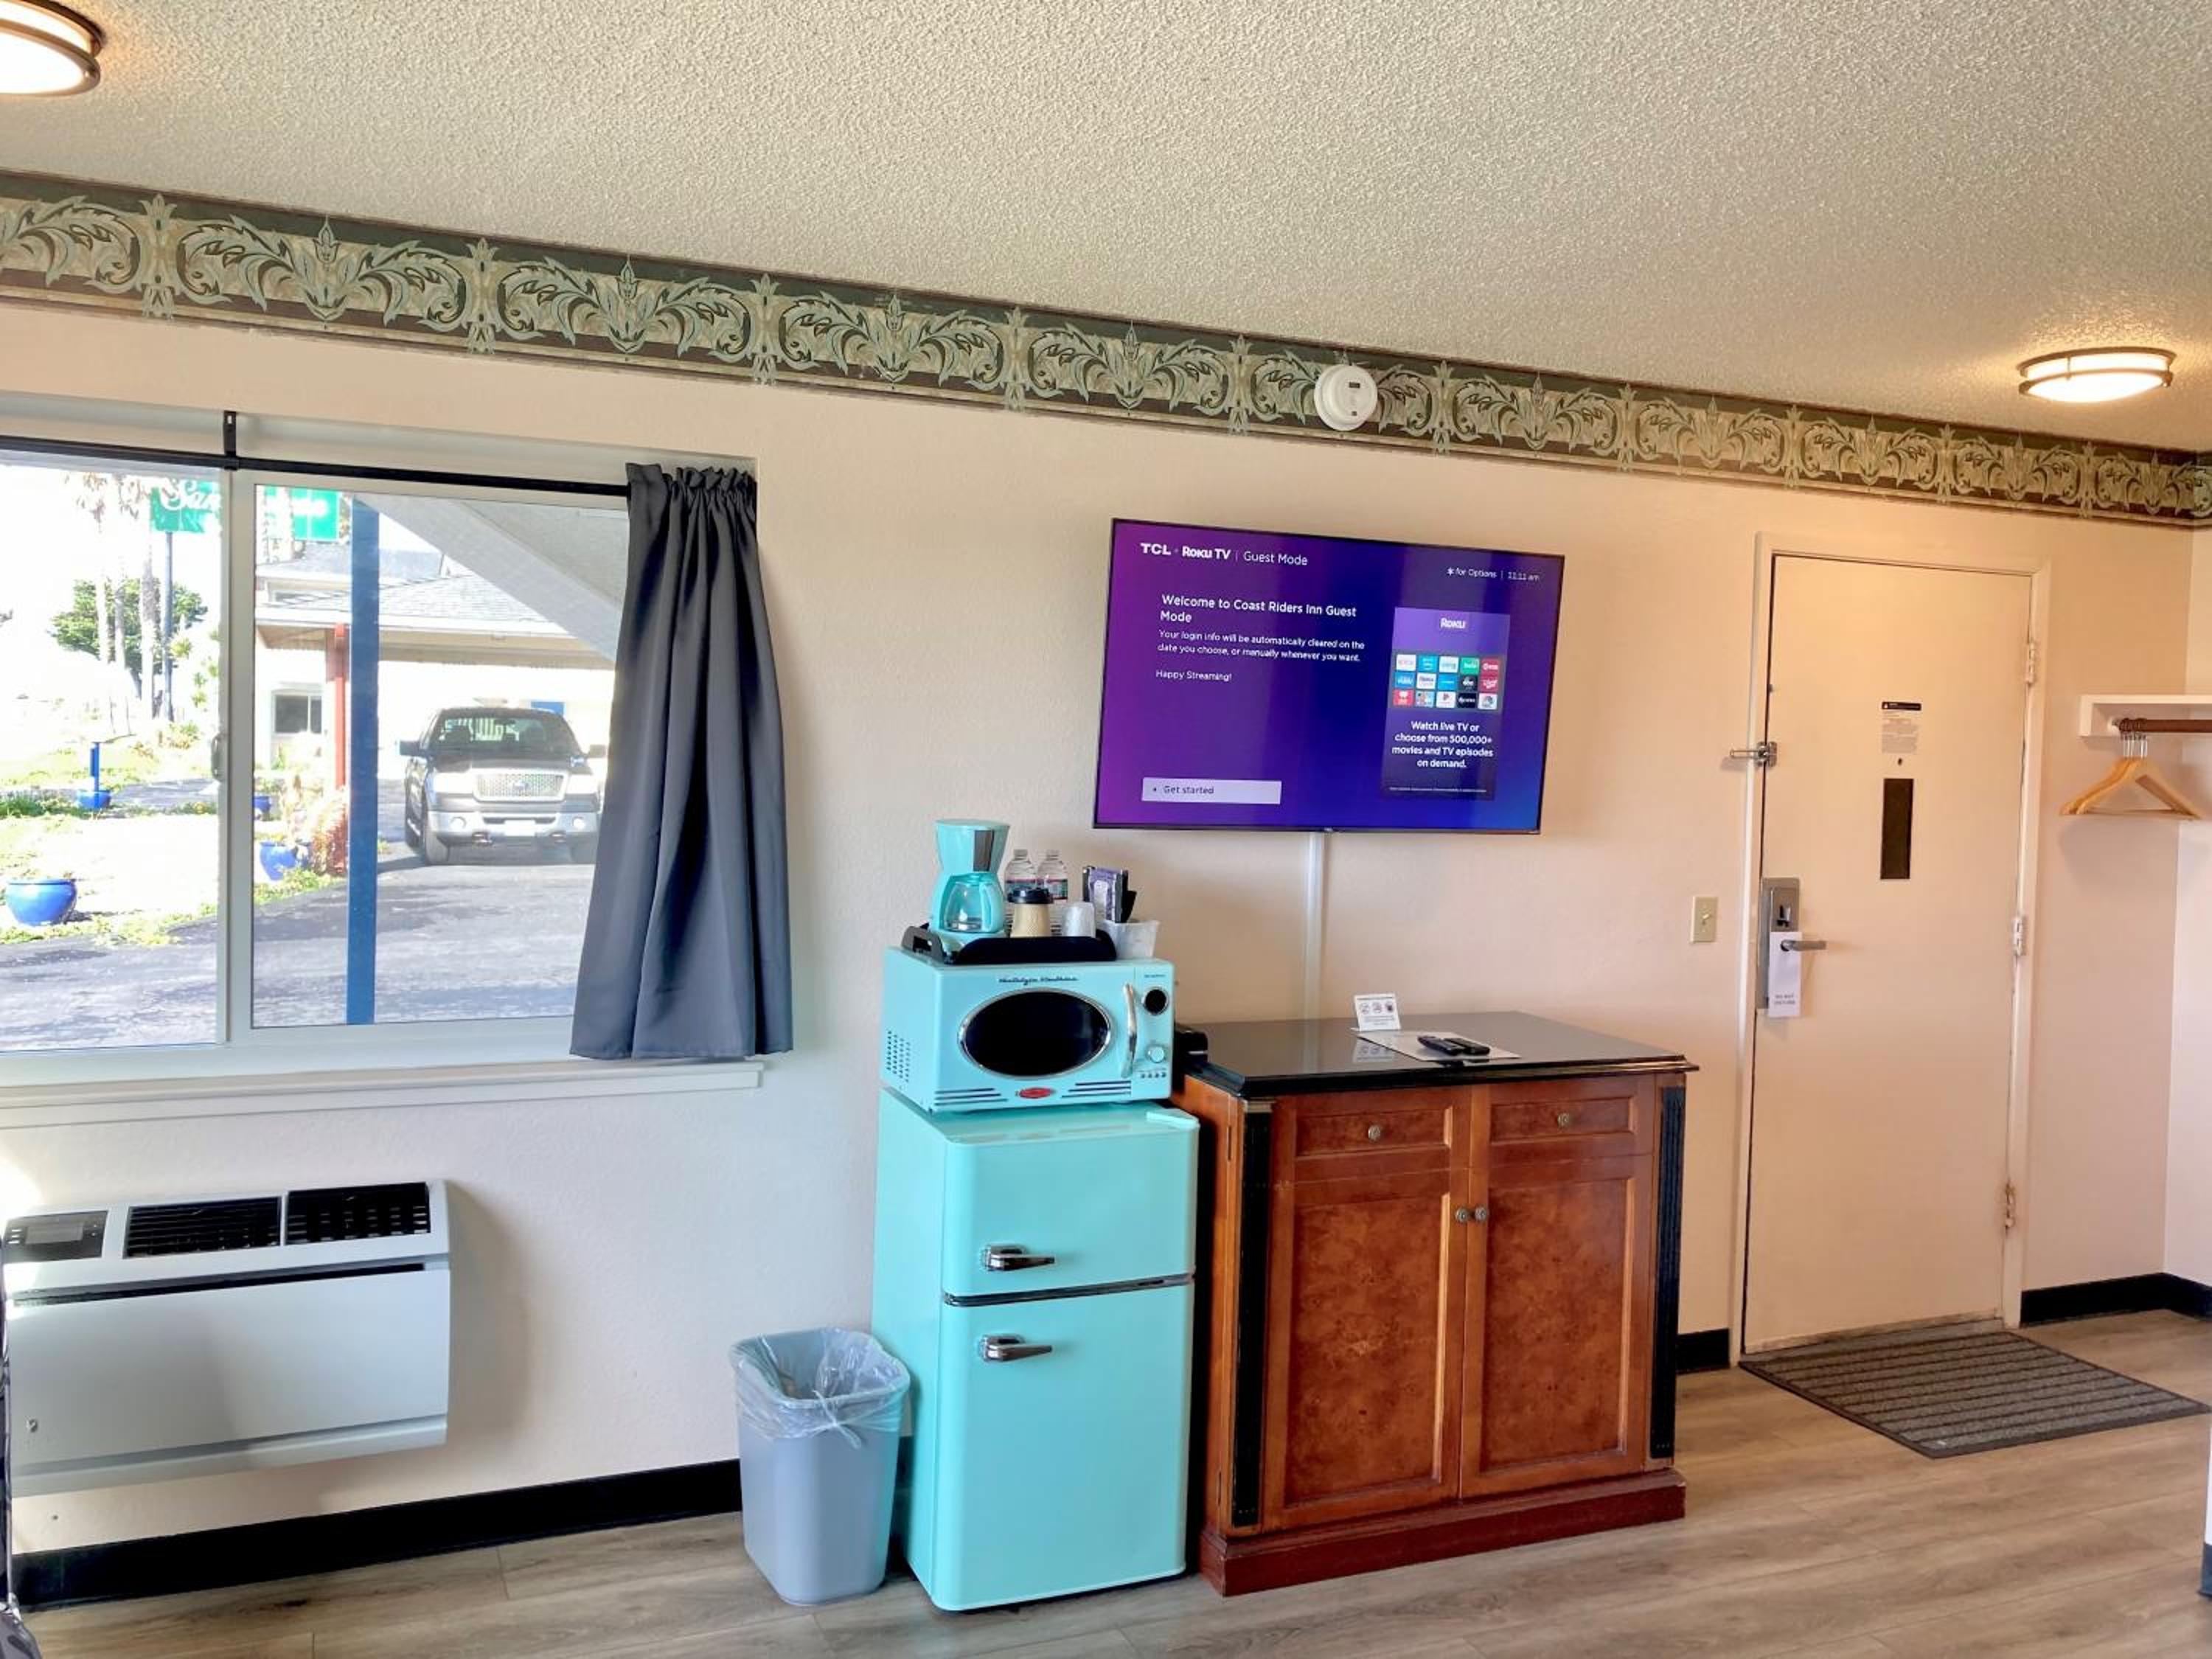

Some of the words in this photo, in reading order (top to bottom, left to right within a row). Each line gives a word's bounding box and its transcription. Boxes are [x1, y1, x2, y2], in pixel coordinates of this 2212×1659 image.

[1141, 543, 1171, 555] TCL
[1214, 548, 1231, 560] TV
[1244, 551, 1274, 563] Guest
[1278, 553, 1308, 566] Mode
[1455, 567, 1466, 575] for
[1468, 568, 1498, 579] Options
[1161, 594, 1215, 608] Welcome
[1218, 599, 1230, 609] to
[1234, 599, 1265, 611] Coast
[1268, 601, 1303, 614] Riders
[1306, 604, 1322, 614] Inn
[1326, 605, 1357, 617] Guest
[1160, 611, 1192, 622] Mode
[1159, 629, 1180, 639] Your
[1181, 631, 1202, 641] login
[1204, 632, 1220, 641] info
[1222, 633, 1237, 642] will
[1239, 634, 1249, 643] be
[1251, 636, 1306, 647] automatically
[1307, 639, 1338, 648] cleared
[1352, 641, 1365, 650] the
[1157, 643, 1178, 652] date
[1179, 645, 1195, 654] you
[1197, 646, 1229, 655] choose,
[1231, 647, 1239, 655] or
[1242, 649, 1279, 658] manually
[1281, 650, 1320, 660] whenever
[1322, 653, 1337, 661] you
[1155, 669, 1183, 680] Happy
[1186, 670, 1232, 682] Streaming!
[1411, 720, 1439, 731] Watch
[1439, 721, 1455, 731] live
[1457, 723, 1469, 731] TV
[1470, 724, 1480, 732] or
[1394, 733, 1426, 742] choose
[1427, 734, 1448, 743] from
[1449, 734, 1492, 745] 500,000+
[1392, 745, 1422, 755] movies
[1425, 746, 1441, 755] and
[1442, 747, 1454, 756] TV
[1455, 747, 1493, 757] episodes
[1416, 759, 1428, 768] on
[1430, 759, 1467, 768] demand.
[1163, 785, 1180, 794] Get
[1182, 785, 1214, 794] started
